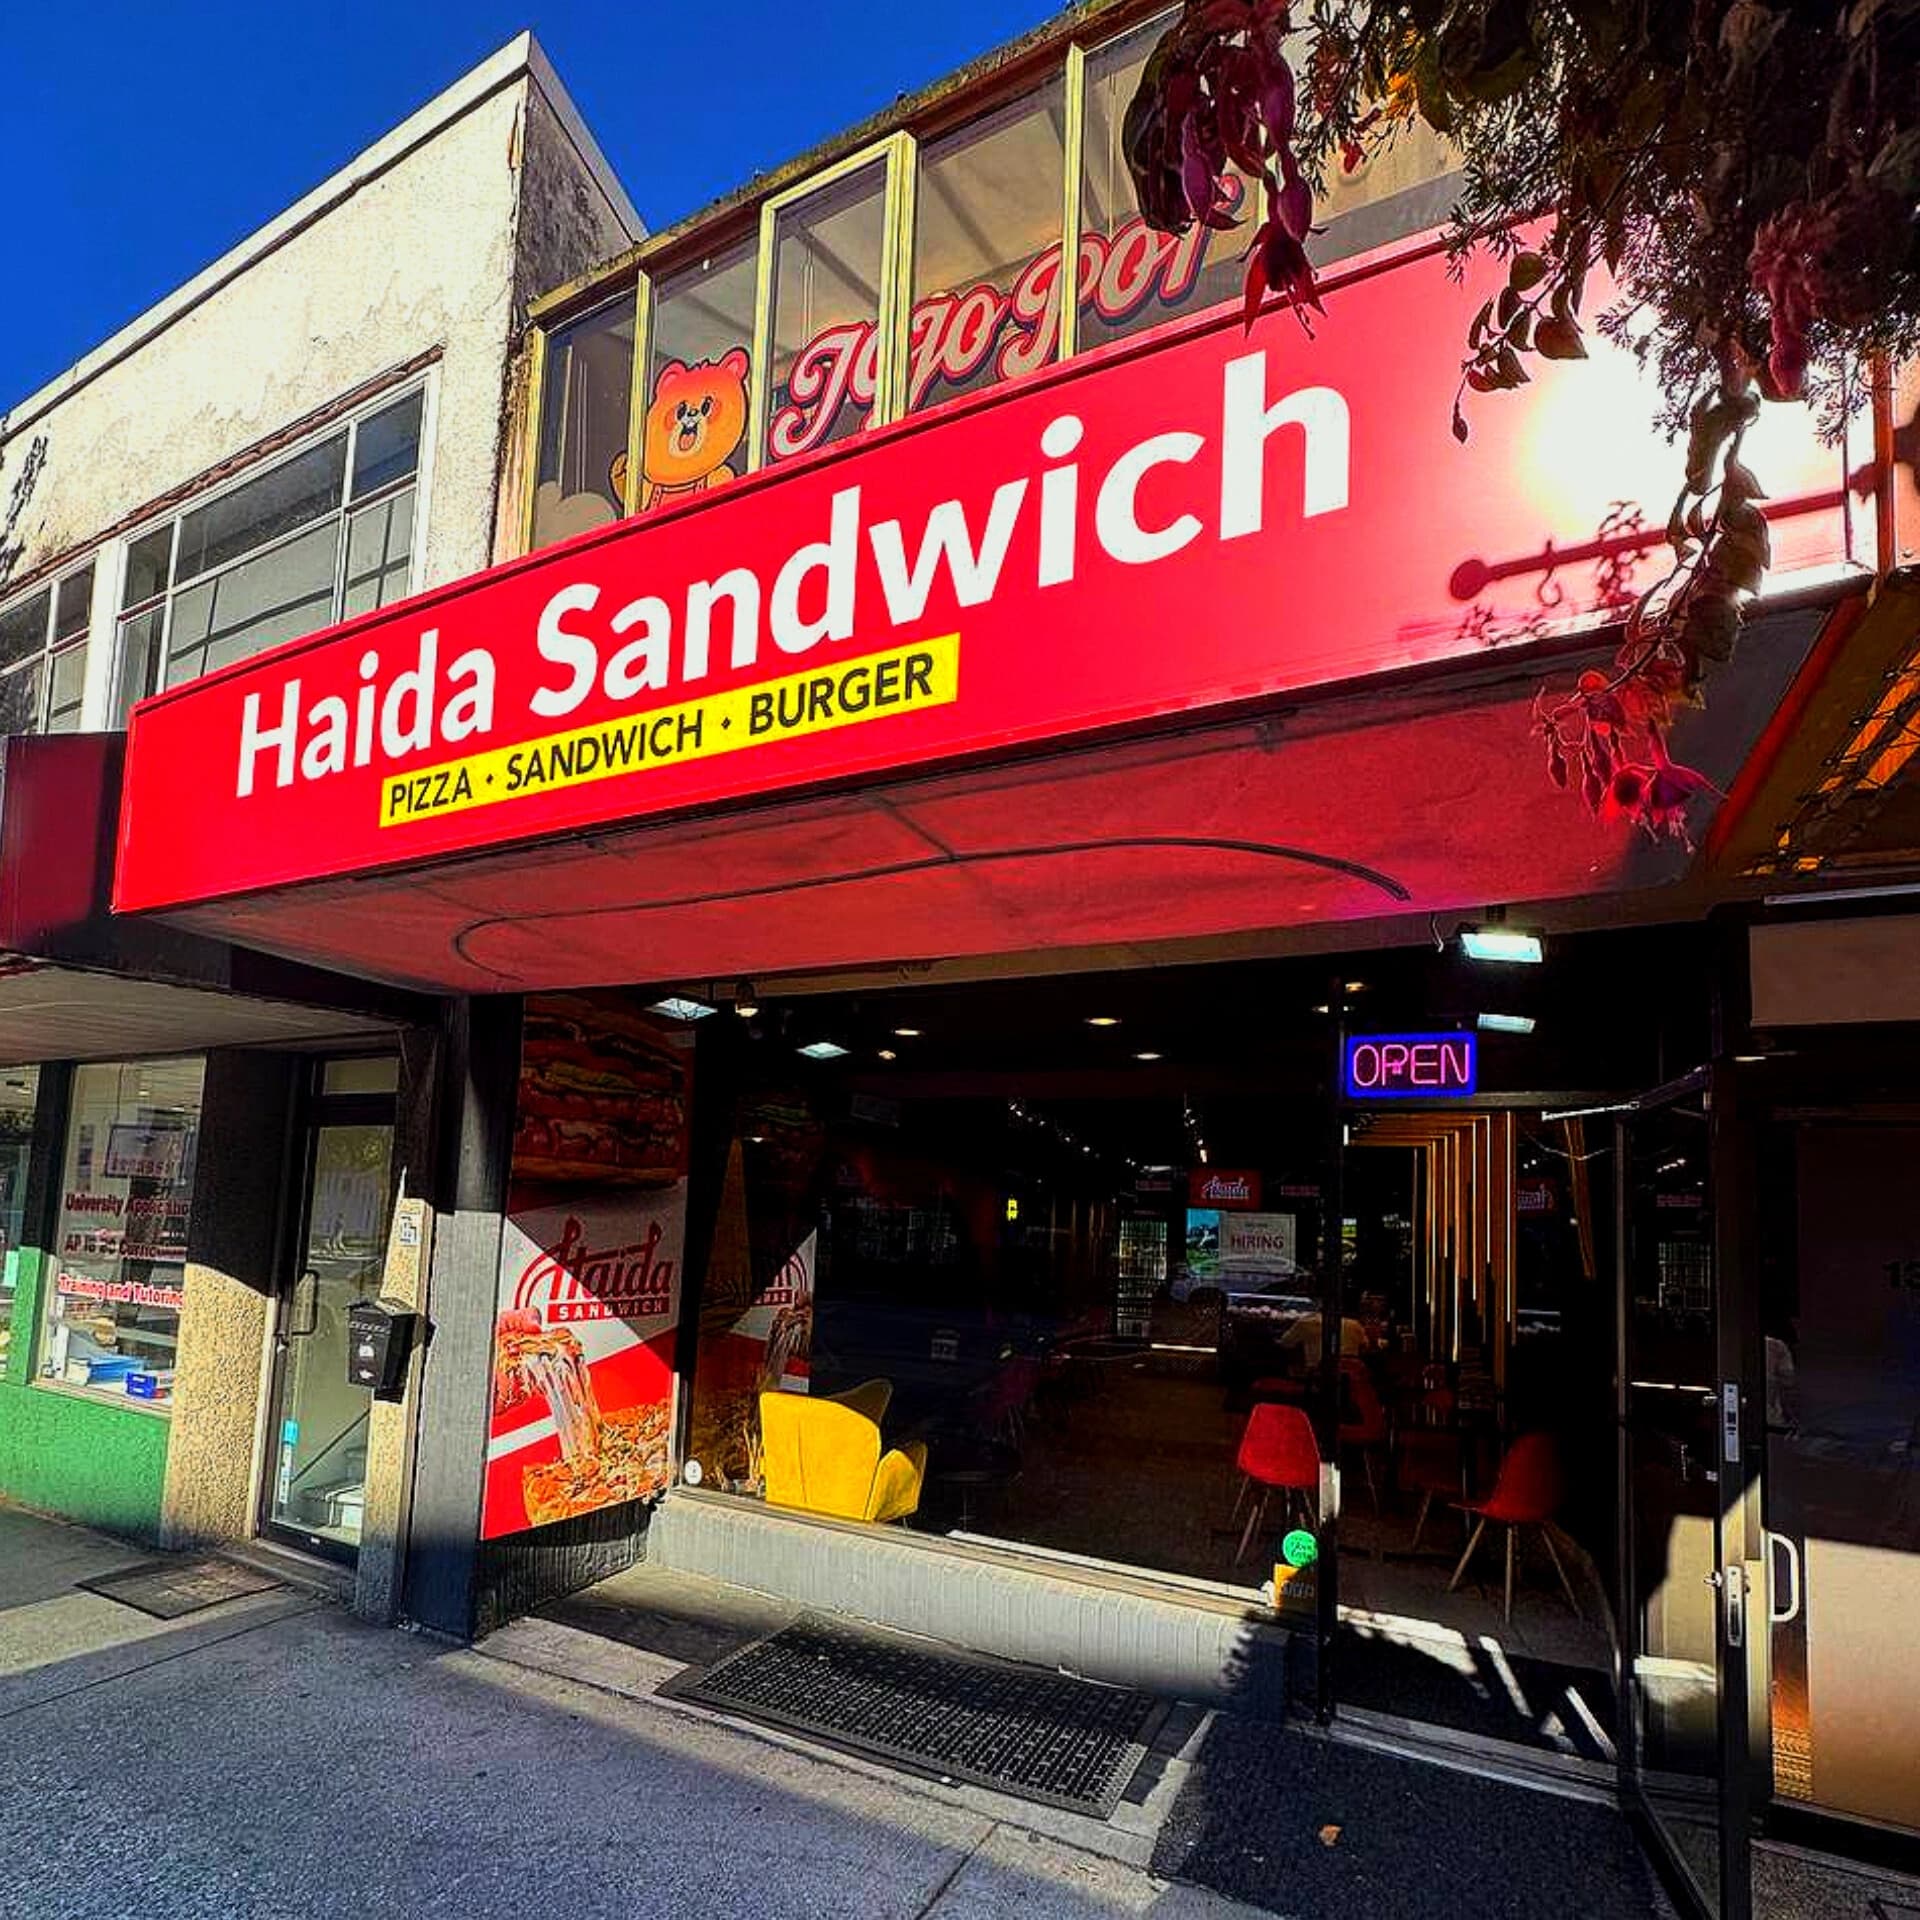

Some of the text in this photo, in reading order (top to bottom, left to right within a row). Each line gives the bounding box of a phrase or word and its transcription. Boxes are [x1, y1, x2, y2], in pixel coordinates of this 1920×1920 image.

[236, 350, 1351, 798] Haida Sandwich
[390, 652, 934, 817] PIZZA SANDWICH BURGER
[1353, 1043, 1471, 1087] OPEN
[65, 1193, 124, 1216] University
[1231, 1234, 1285, 1251] HIRING
[514, 1215, 674, 1308] Haida
[58, 1274, 106, 1300] Training
[107, 1282, 131, 1300] and
[557, 1300, 666, 1322] SANDWICH
